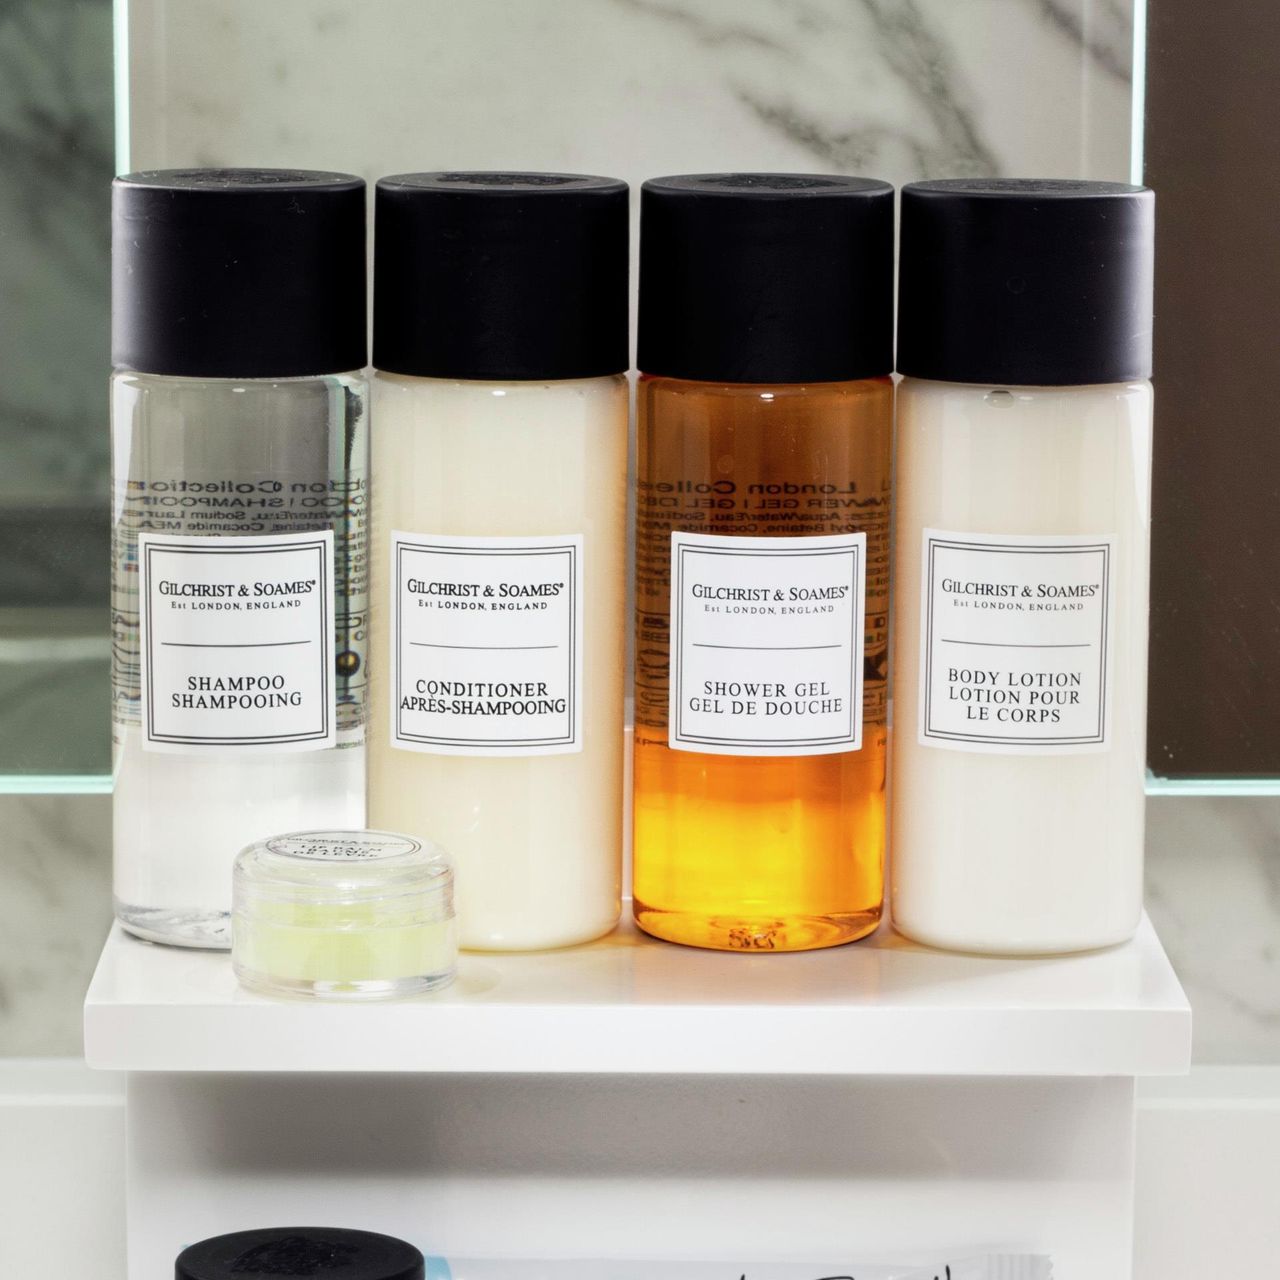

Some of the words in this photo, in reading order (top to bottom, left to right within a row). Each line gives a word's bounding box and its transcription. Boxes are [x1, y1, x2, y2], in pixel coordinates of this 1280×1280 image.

[158, 580, 236, 598] GILCHRIST
[237, 584, 250, 597] &
[407, 578, 481, 597] GILCHRIST
[482, 584, 495, 598] &
[691, 583, 771, 602] GILCHRIST
[773, 589, 785, 602] &
[941, 578, 1019, 597] GILCHRIST
[1020, 585, 1033, 598] &
[246, 599, 301, 611] ENGLAND
[490, 601, 548, 611] ENGLAND
[781, 604, 834, 615] ENGLAND
[1028, 603, 1084, 612] ENGLAND
[187, 675, 285, 692] SHAMPOO
[948, 667, 1000, 686] BODY
[1008, 672, 1081, 687] LOTION
[415, 679, 549, 699] CONDITIONER
[704, 680, 787, 698] SHOWER
[794, 681, 830, 698] GEL
[949, 686, 1022, 705] LOTION
[1029, 690, 1080, 705] POUR
[171, 691, 302, 710] SHAMPOOING
[401, 694, 566, 716] APRÈS-SHAMPOOING
[689, 697, 724, 714] GEL
[731, 700, 757, 716] DE
[765, 697, 842, 716] DOUCHE
[967, 705, 989, 721] LE
[996, 708, 1061, 723] CORPS
